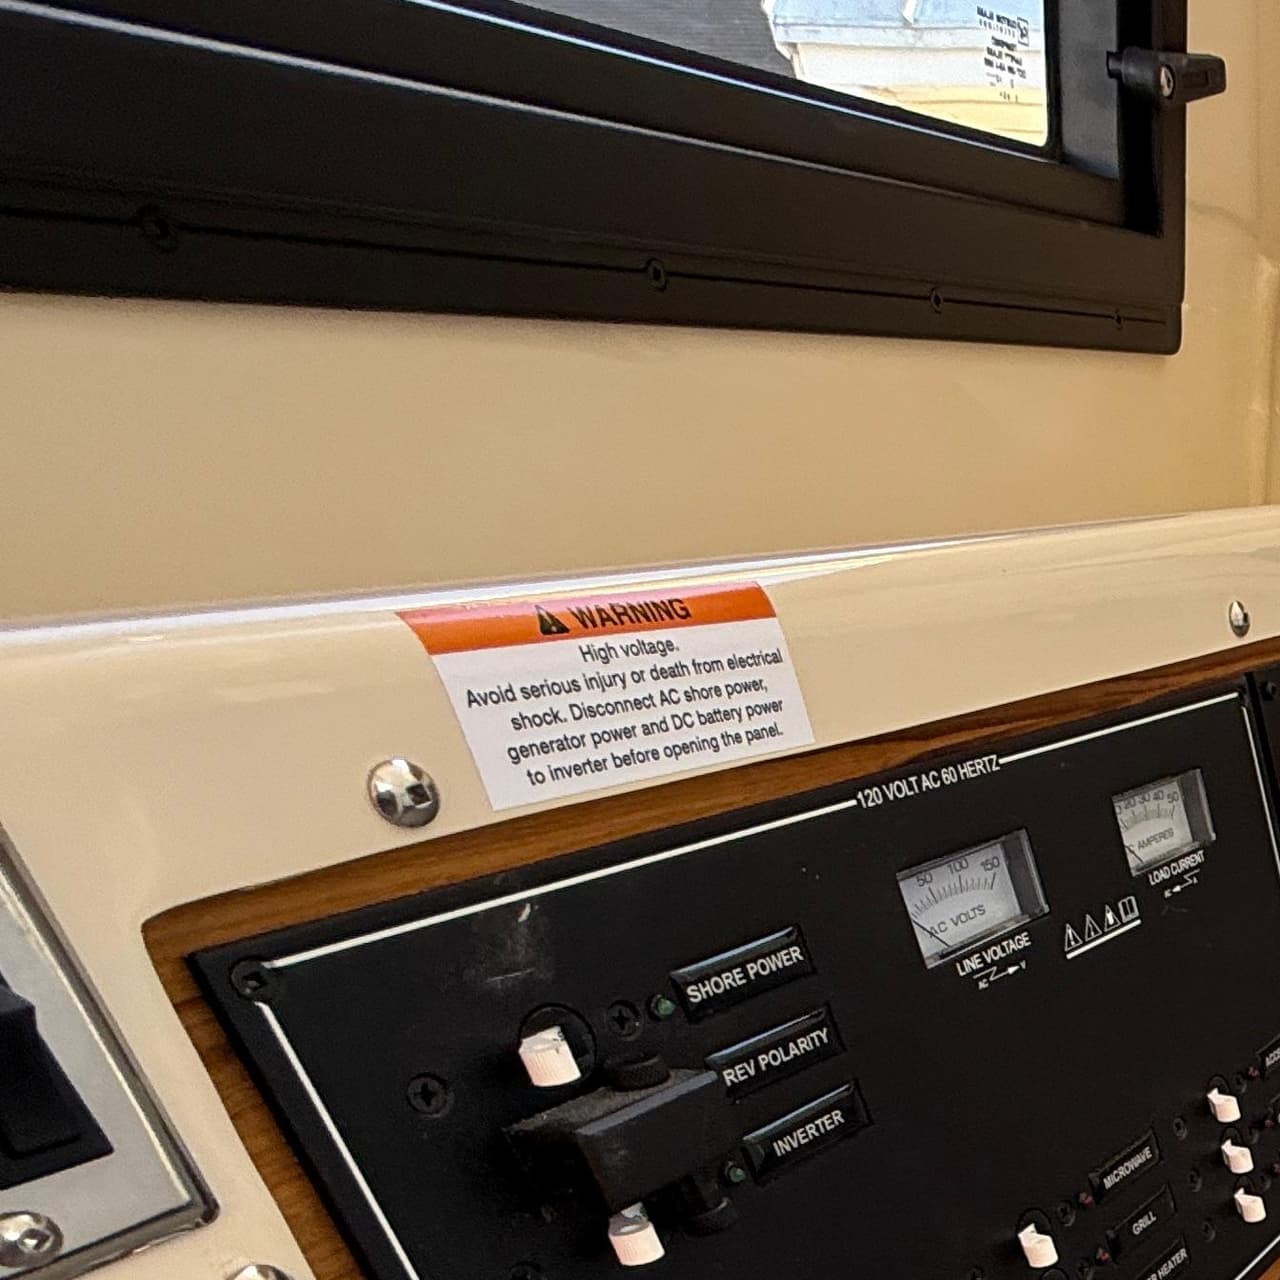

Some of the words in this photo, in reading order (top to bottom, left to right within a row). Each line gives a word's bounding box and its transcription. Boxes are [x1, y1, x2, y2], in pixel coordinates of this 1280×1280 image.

[570, 597, 692, 630] WARNING
[579, 640, 619, 665] High
[620, 635, 679, 661] voltage.
[466, 681, 517, 709] Avoid
[520, 675, 582, 702] serious
[585, 669, 627, 695] injury
[630, 668, 646, 684] or
[649, 660, 690, 682] death
[691, 655, 724, 677] from
[726, 648, 783, 673] electrical
[511, 708, 568, 733] shock.
[571, 692, 657, 722] Disconnect
[659, 687, 682, 707] AC
[683, 682, 722, 704] shore
[724, 677, 769, 701] power,
[507, 734, 588, 765] generator
[590, 725, 638, 754] power
[641, 715, 670, 737] and
[671, 710, 696, 731] DC
[698, 703, 744, 731] battery
[745, 699, 784, 724] power
[527, 768, 547, 787] to
[549, 755, 609, 782] inverter
[611, 744, 661, 770] before
[663, 734, 720, 762] opening
[721, 725, 743, 746] the
[744, 722, 785, 749] panel.
[856, 786, 883, 810] 120
[883, 774, 920, 802] VOLT
[920, 767, 942, 793] AC
[941, 764, 958, 787] 60
[958, 754, 1001, 781] HERTZ
[916, 871, 934, 888] 50
[948, 858, 970, 876] 100
[980, 855, 1001, 873] 150
[1148, 866, 1171, 886] LOAD
[1169, 849, 1205, 876] CURRENT
[929, 920, 948, 938] AC
[950, 903, 986, 929] VOLTS
[686, 966, 747, 1005] SHORE
[746, 945, 804, 981] POWER
[955, 950, 983, 977] LINE
[983, 932, 1032, 963] VOLTAGE
[722, 1057, 755, 1087] REV
[758, 1027, 830, 1072] POLARITY
[772, 1109, 846, 1158] INVERTER
[1102, 1146, 1154, 1190] MICROWAVE
[1131, 1211, 1157, 1237] GRILL
[1157, 1247, 1188, 1280] HEATER
